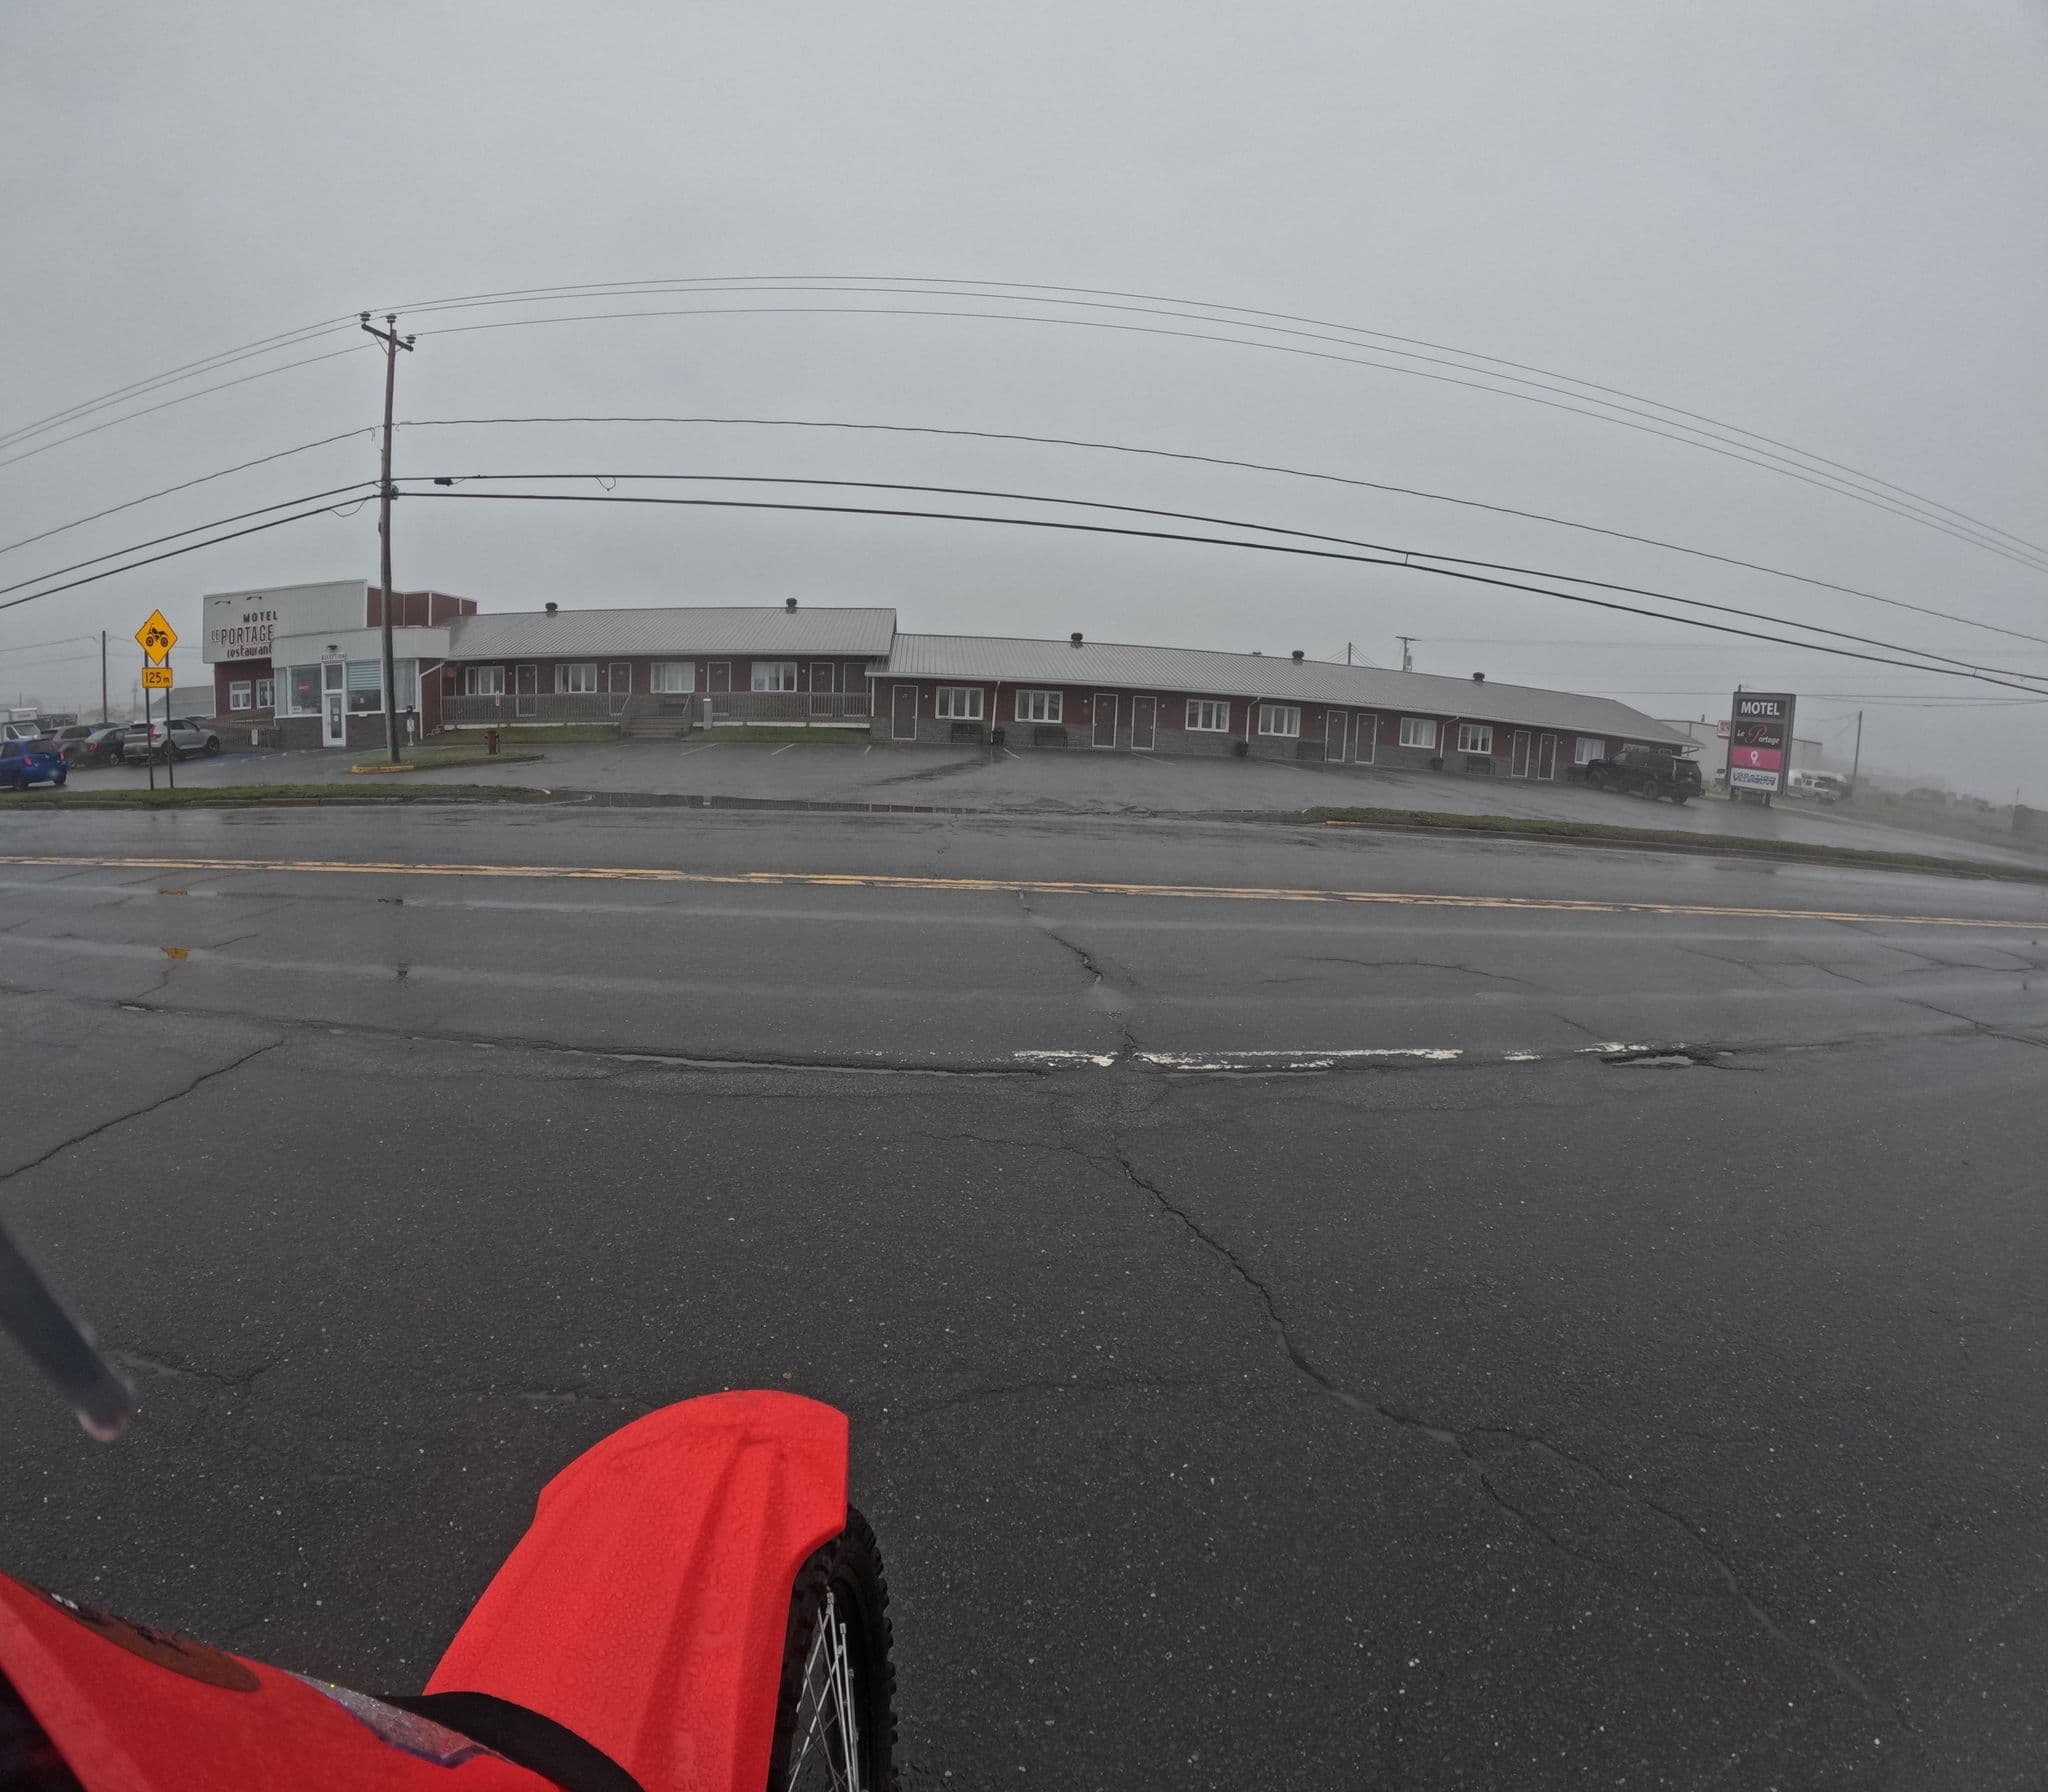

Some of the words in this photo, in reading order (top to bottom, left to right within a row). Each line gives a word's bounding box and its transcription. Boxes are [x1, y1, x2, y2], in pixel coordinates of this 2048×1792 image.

[243, 611, 278, 622] MOTEL
[211, 629, 220, 641] LE
[221, 624, 273, 645] PORTAGE
[145, 672, 162, 683] 125
[1741, 701, 1780, 716] MOTEL
[1737, 729, 1745, 737] Le
[1745, 724, 1780, 745] Portage
